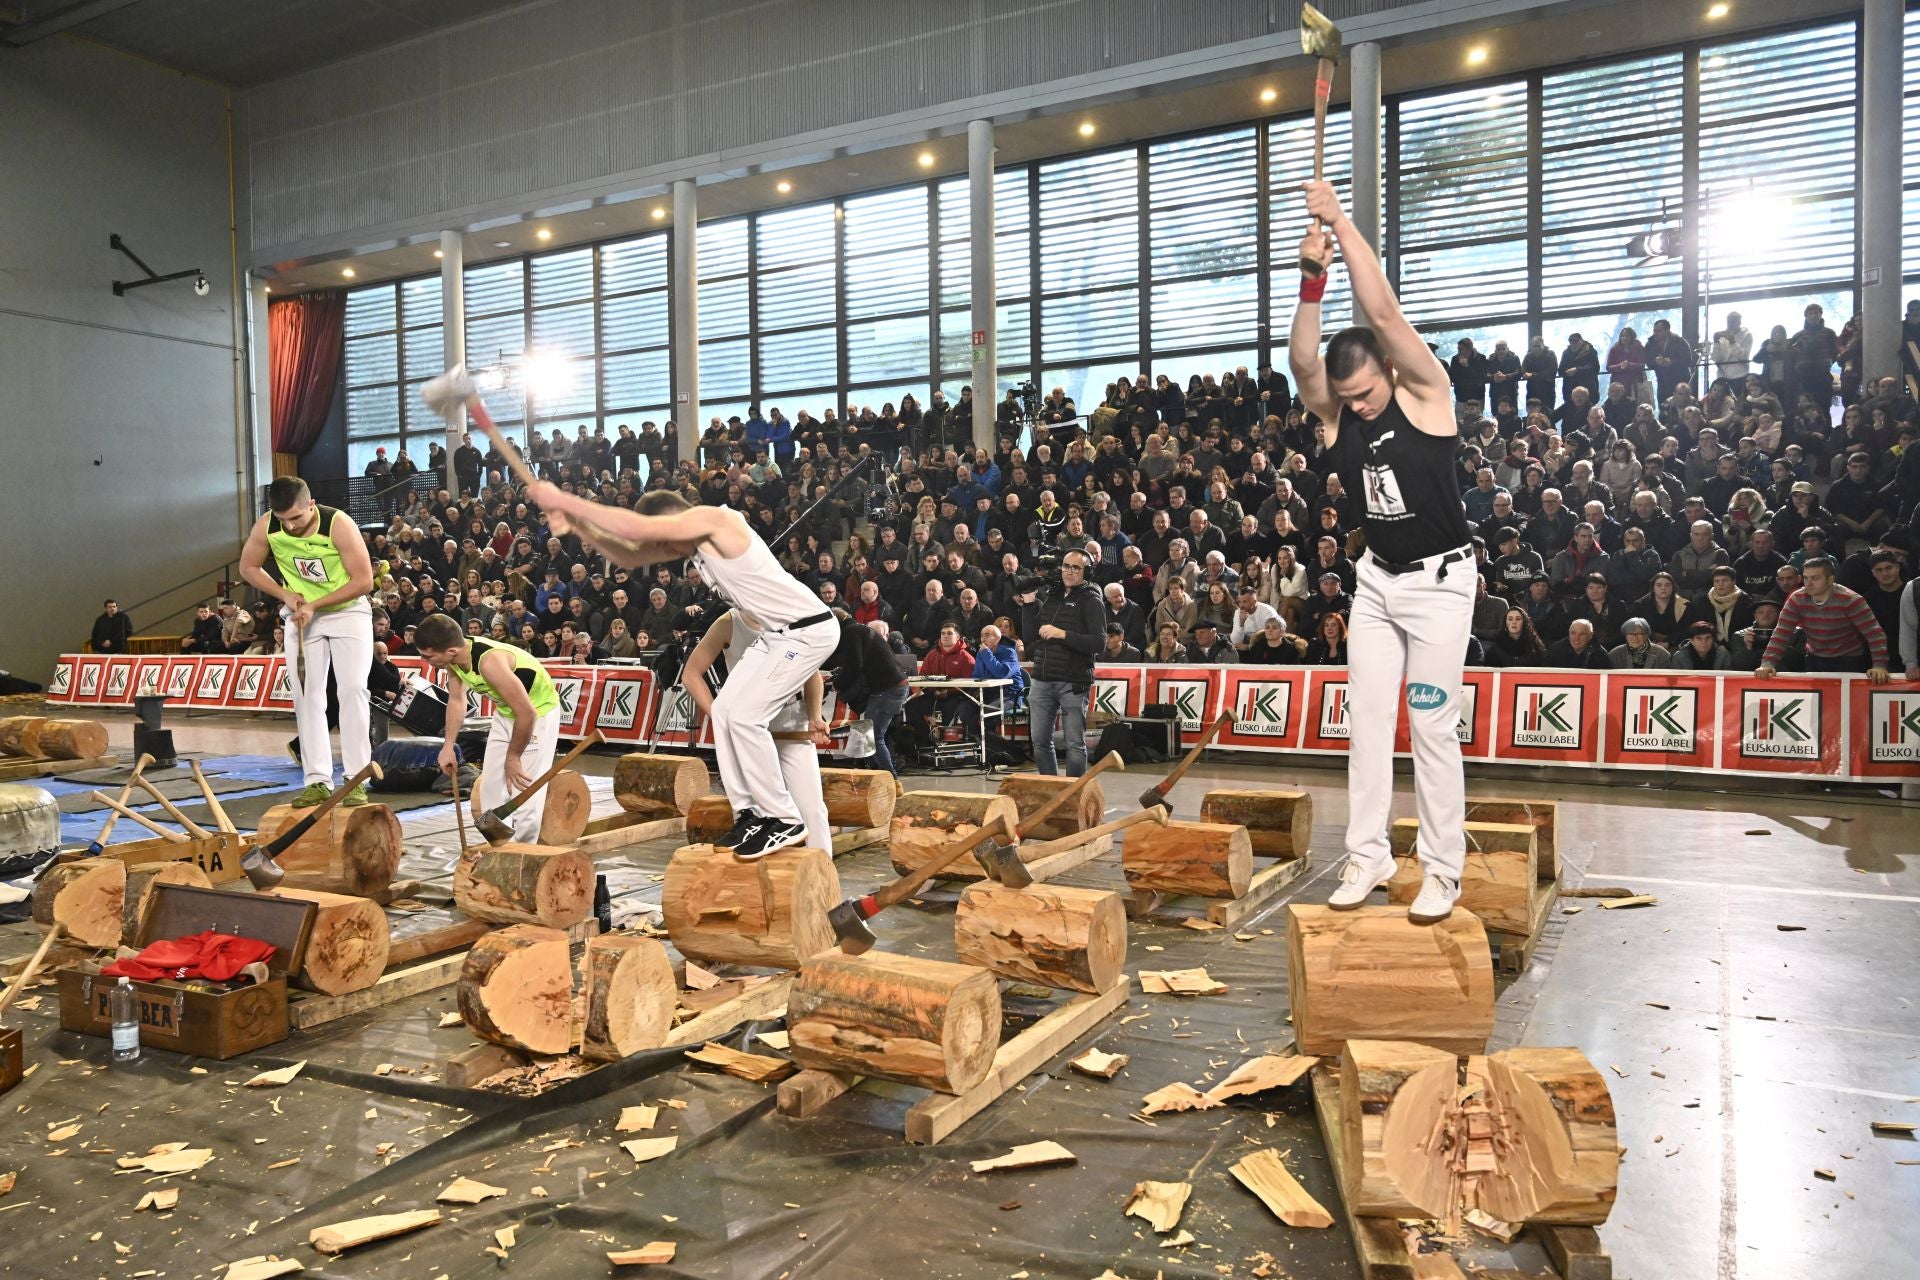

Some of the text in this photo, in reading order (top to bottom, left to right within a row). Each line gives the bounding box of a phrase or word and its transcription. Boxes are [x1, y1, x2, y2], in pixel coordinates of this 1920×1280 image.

[1408, 687, 1441, 704] Mahala
[597, 716, 632, 726] EUSKO LABEL
[1181, 721, 1200, 729] ABEL
[1235, 723, 1283, 733] EUSKO LABEL
[1322, 726, 1348, 735] EUSKO
[1516, 733, 1577, 745] EUSKO LABEL
[1626, 738, 1691, 749] EUSKO LABEL
[1745, 743, 1816, 755] EUSKO LABEL
[1875, 747, 1912, 758] EUSKO
